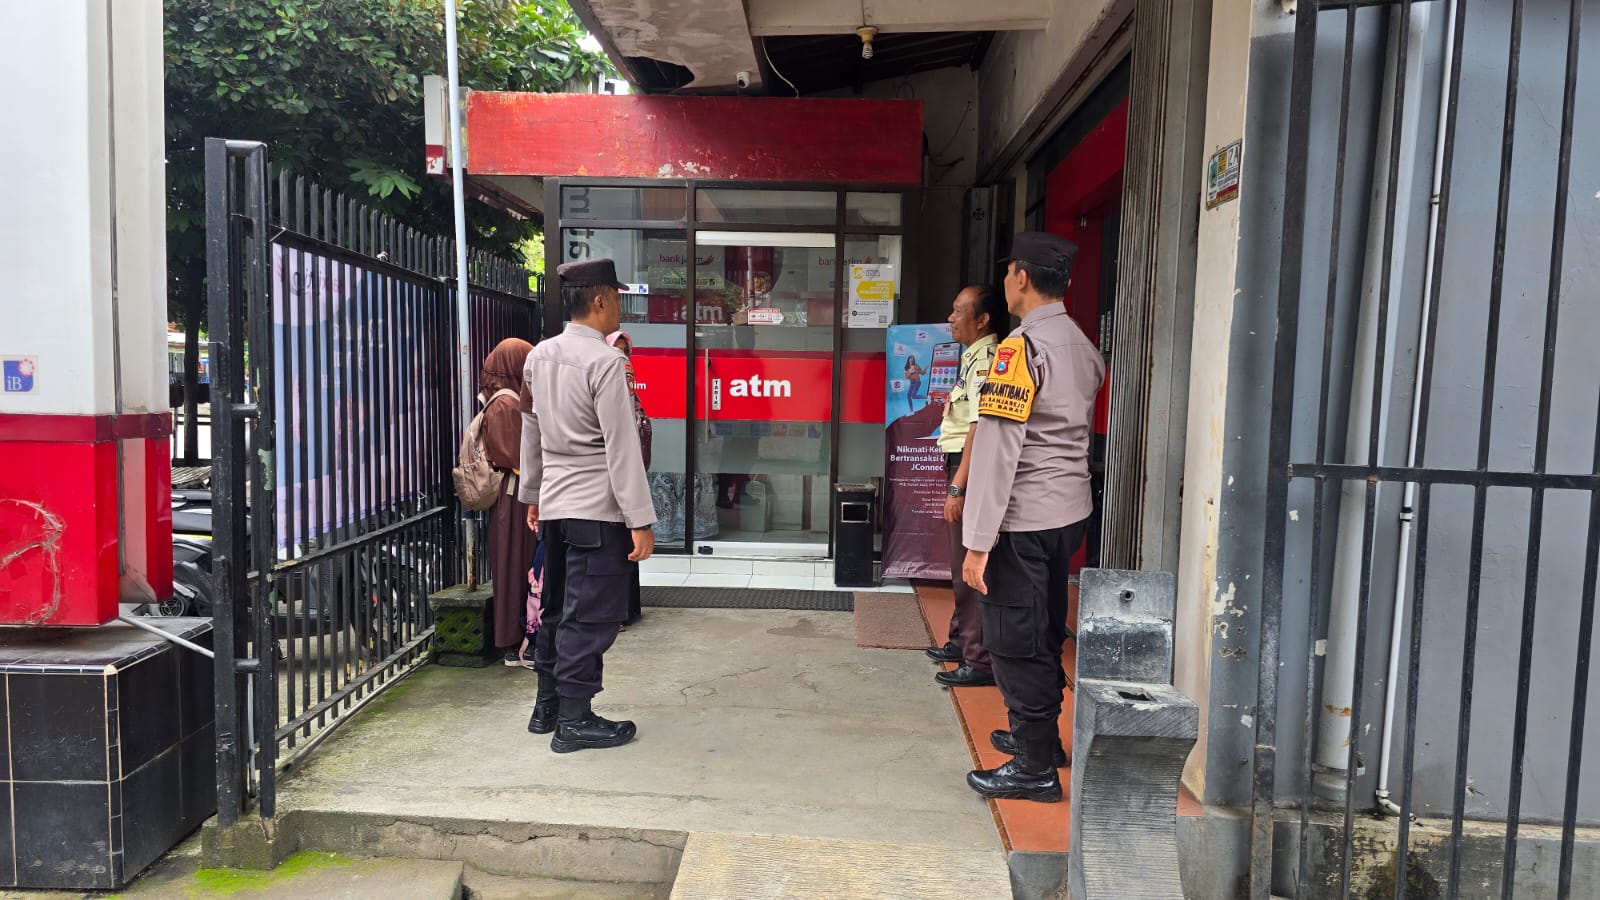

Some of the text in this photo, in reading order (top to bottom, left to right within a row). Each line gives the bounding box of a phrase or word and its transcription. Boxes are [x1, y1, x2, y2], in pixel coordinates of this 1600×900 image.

[7, 376, 22, 390] iB
[729, 374, 791, 397] atm
[988, 396, 1025, 409] BANJAREJO
[998, 404, 1024, 414] BARAT
[896, 445, 928, 453] Nikmati
[890, 454, 939, 462] Bertransaksi
